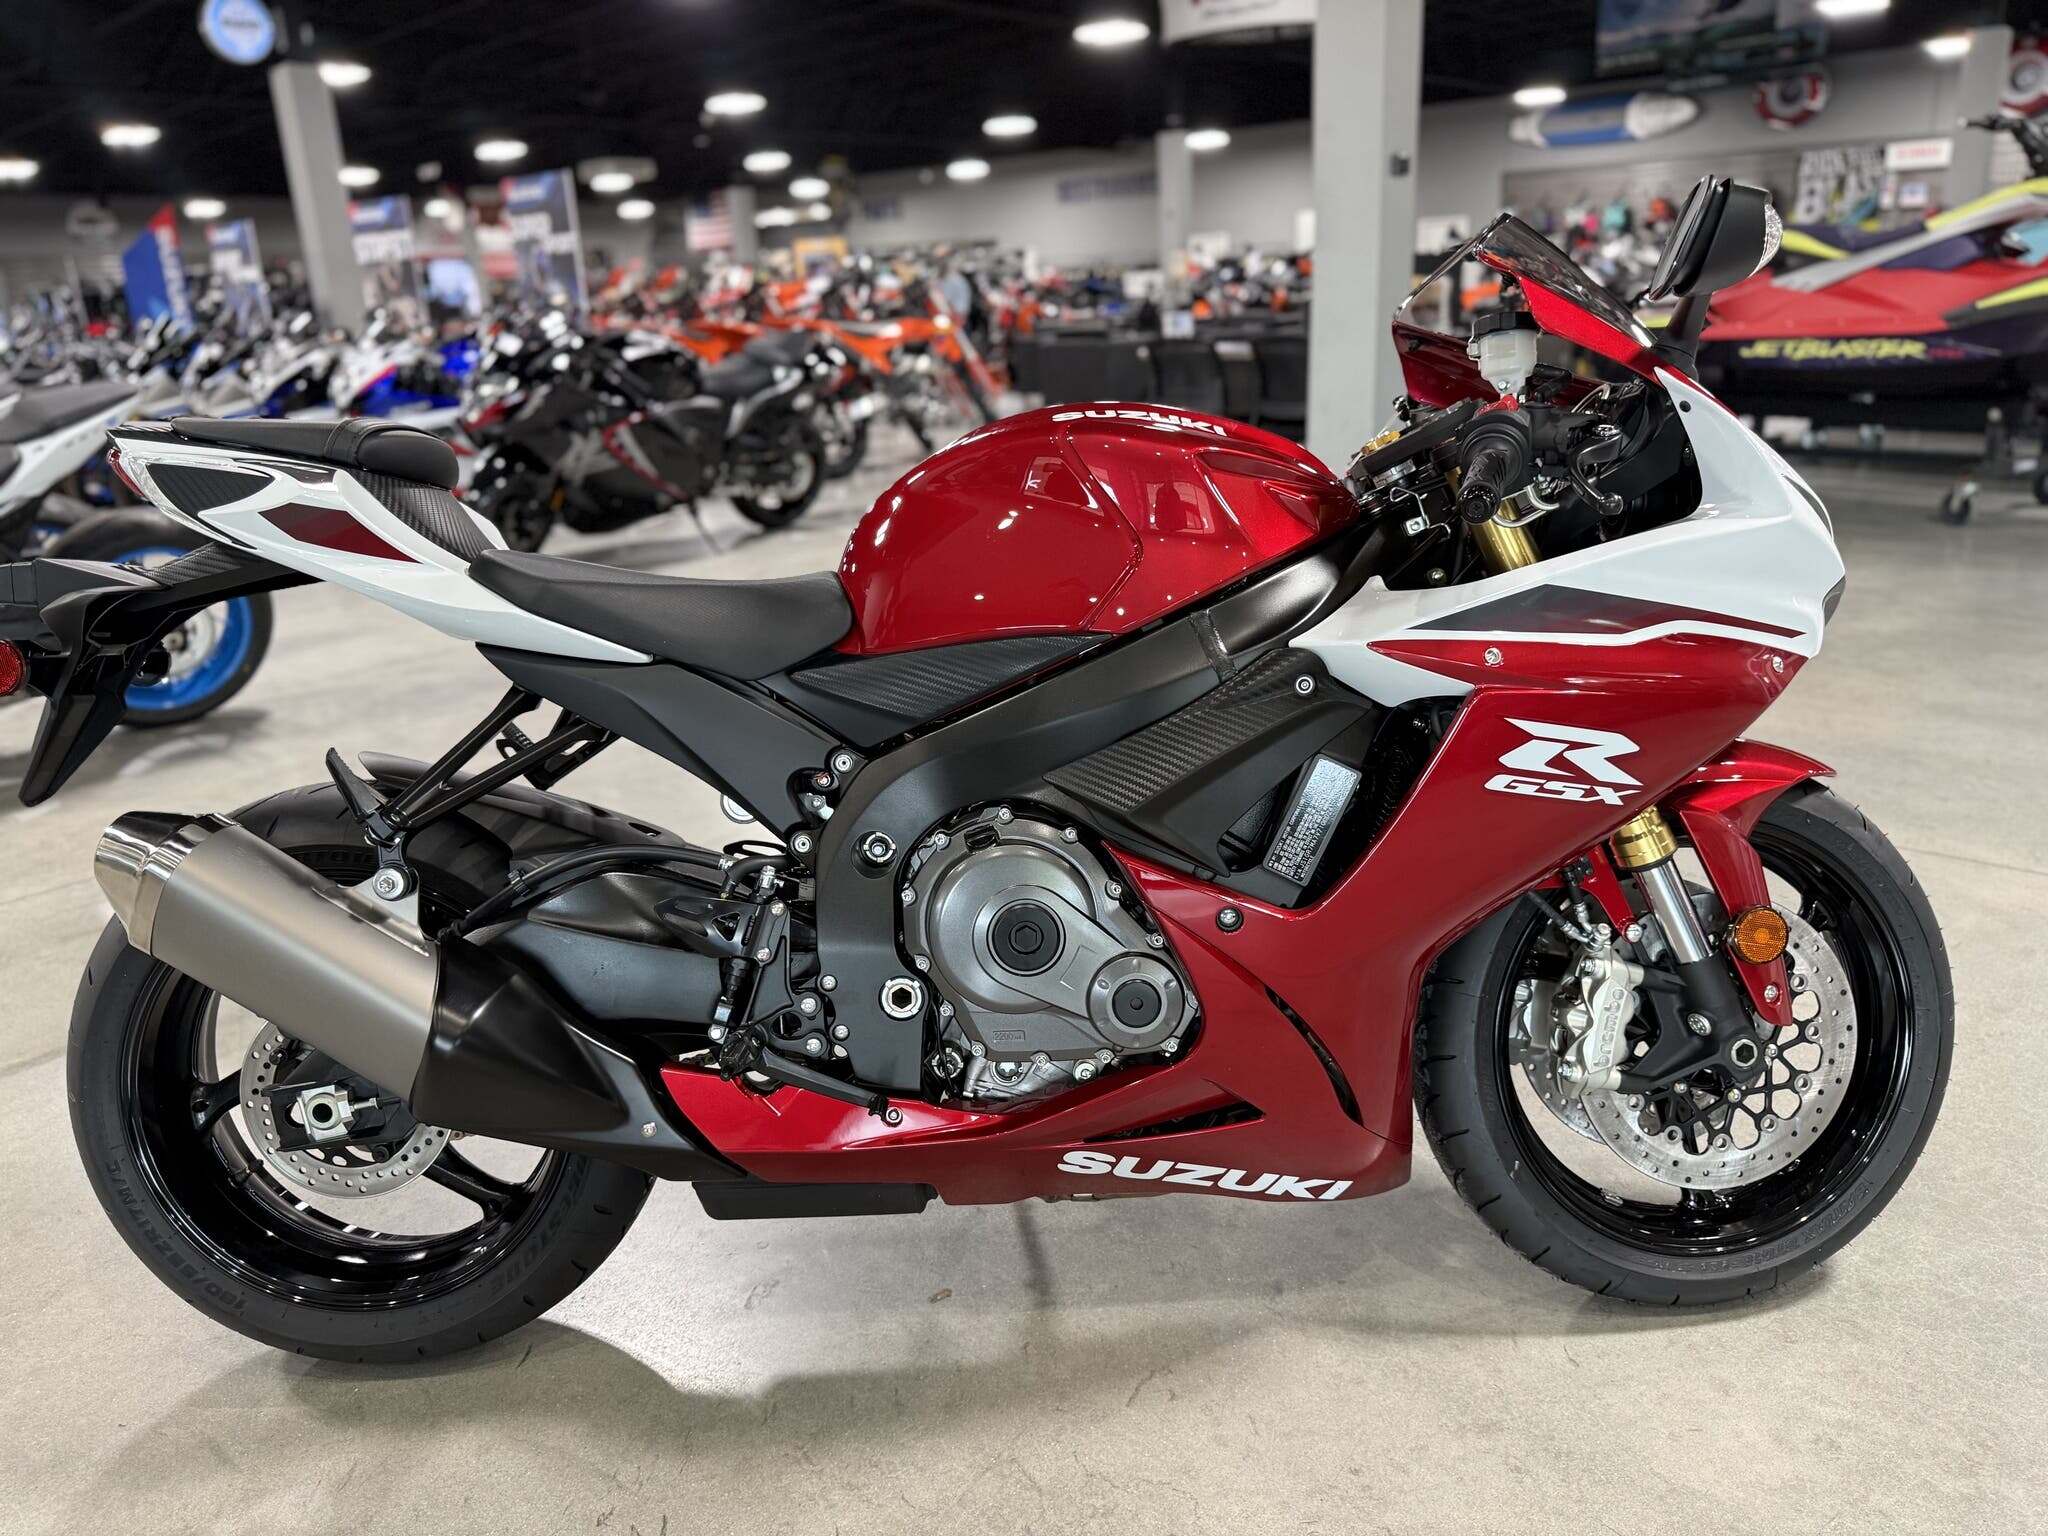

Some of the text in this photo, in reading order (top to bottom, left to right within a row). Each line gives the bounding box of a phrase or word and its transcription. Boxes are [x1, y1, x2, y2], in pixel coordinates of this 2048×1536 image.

[1052, 410, 1227, 437] SUZUKI
[1498, 717, 1644, 786] R
[1484, 774, 1642, 806] GSX
[1593, 989, 1624, 1067] brembo
[1057, 1150, 1353, 1200] SUZUKI
